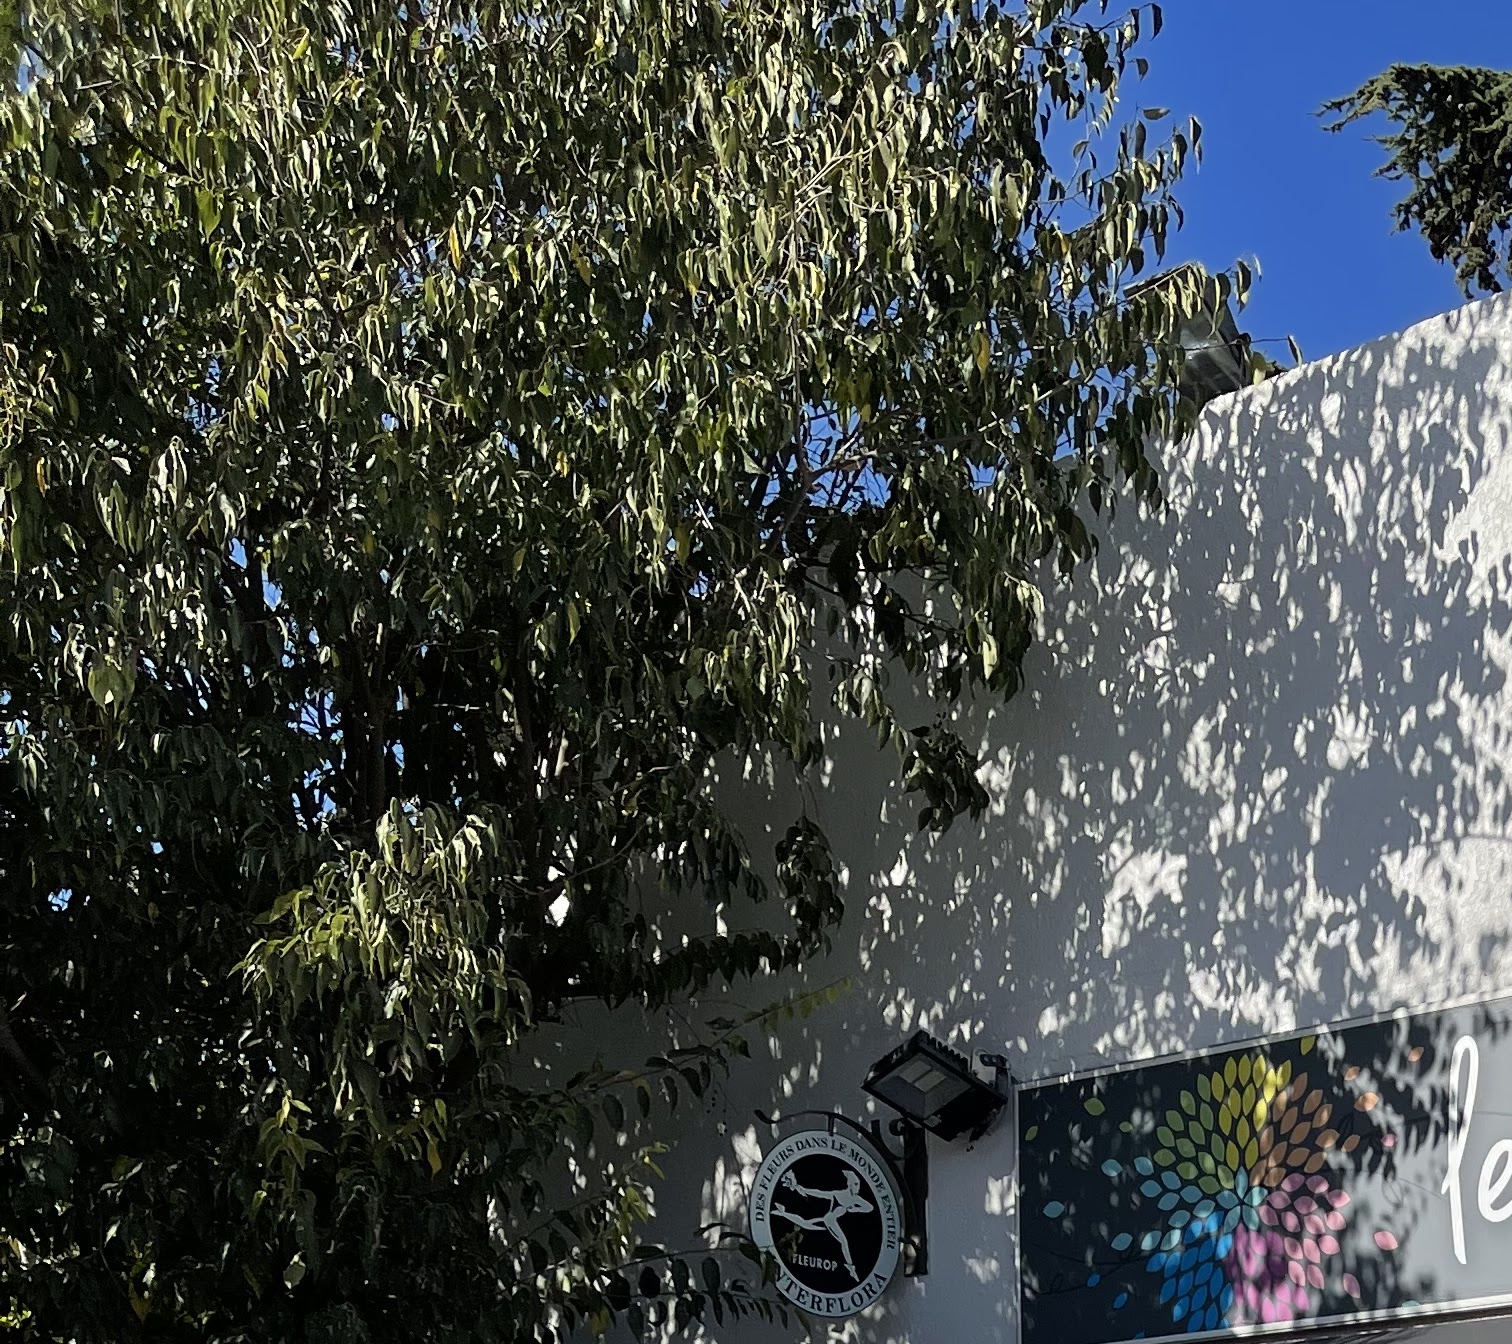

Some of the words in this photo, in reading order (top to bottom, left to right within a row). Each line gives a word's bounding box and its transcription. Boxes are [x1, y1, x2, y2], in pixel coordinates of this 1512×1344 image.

[755, 1194, 766, 1223] DES
[763, 1144, 795, 1192] FLEURS
[796, 1136, 829, 1151] DANS
[830, 1141, 848, 1153] LE
[849, 1149, 888, 1193] MONDE
[881, 1194, 896, 1250] ENTIER
[792, 1252, 838, 1272] FLEUROP
[773, 1272, 887, 1314] TERFLORA
